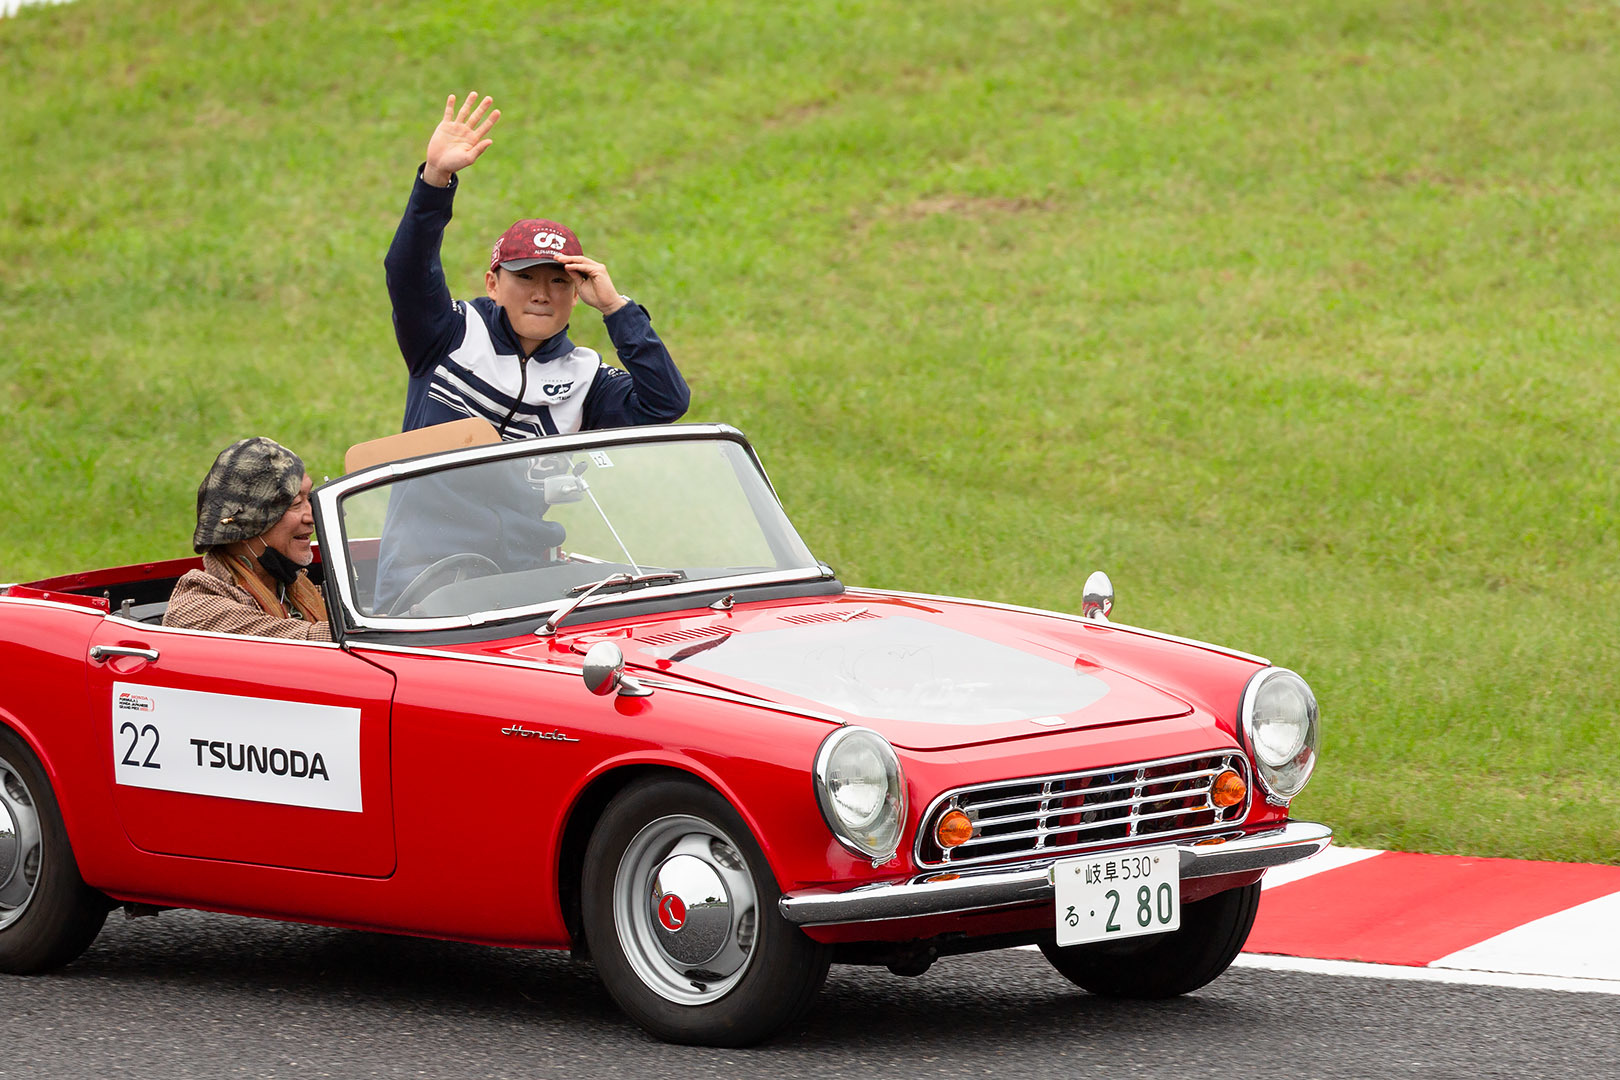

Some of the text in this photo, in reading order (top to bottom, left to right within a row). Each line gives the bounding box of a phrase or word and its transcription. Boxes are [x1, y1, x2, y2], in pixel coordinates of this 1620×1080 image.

[119, 721, 330, 781] 22 TSUNODA
[501, 724, 580, 742] Honda
